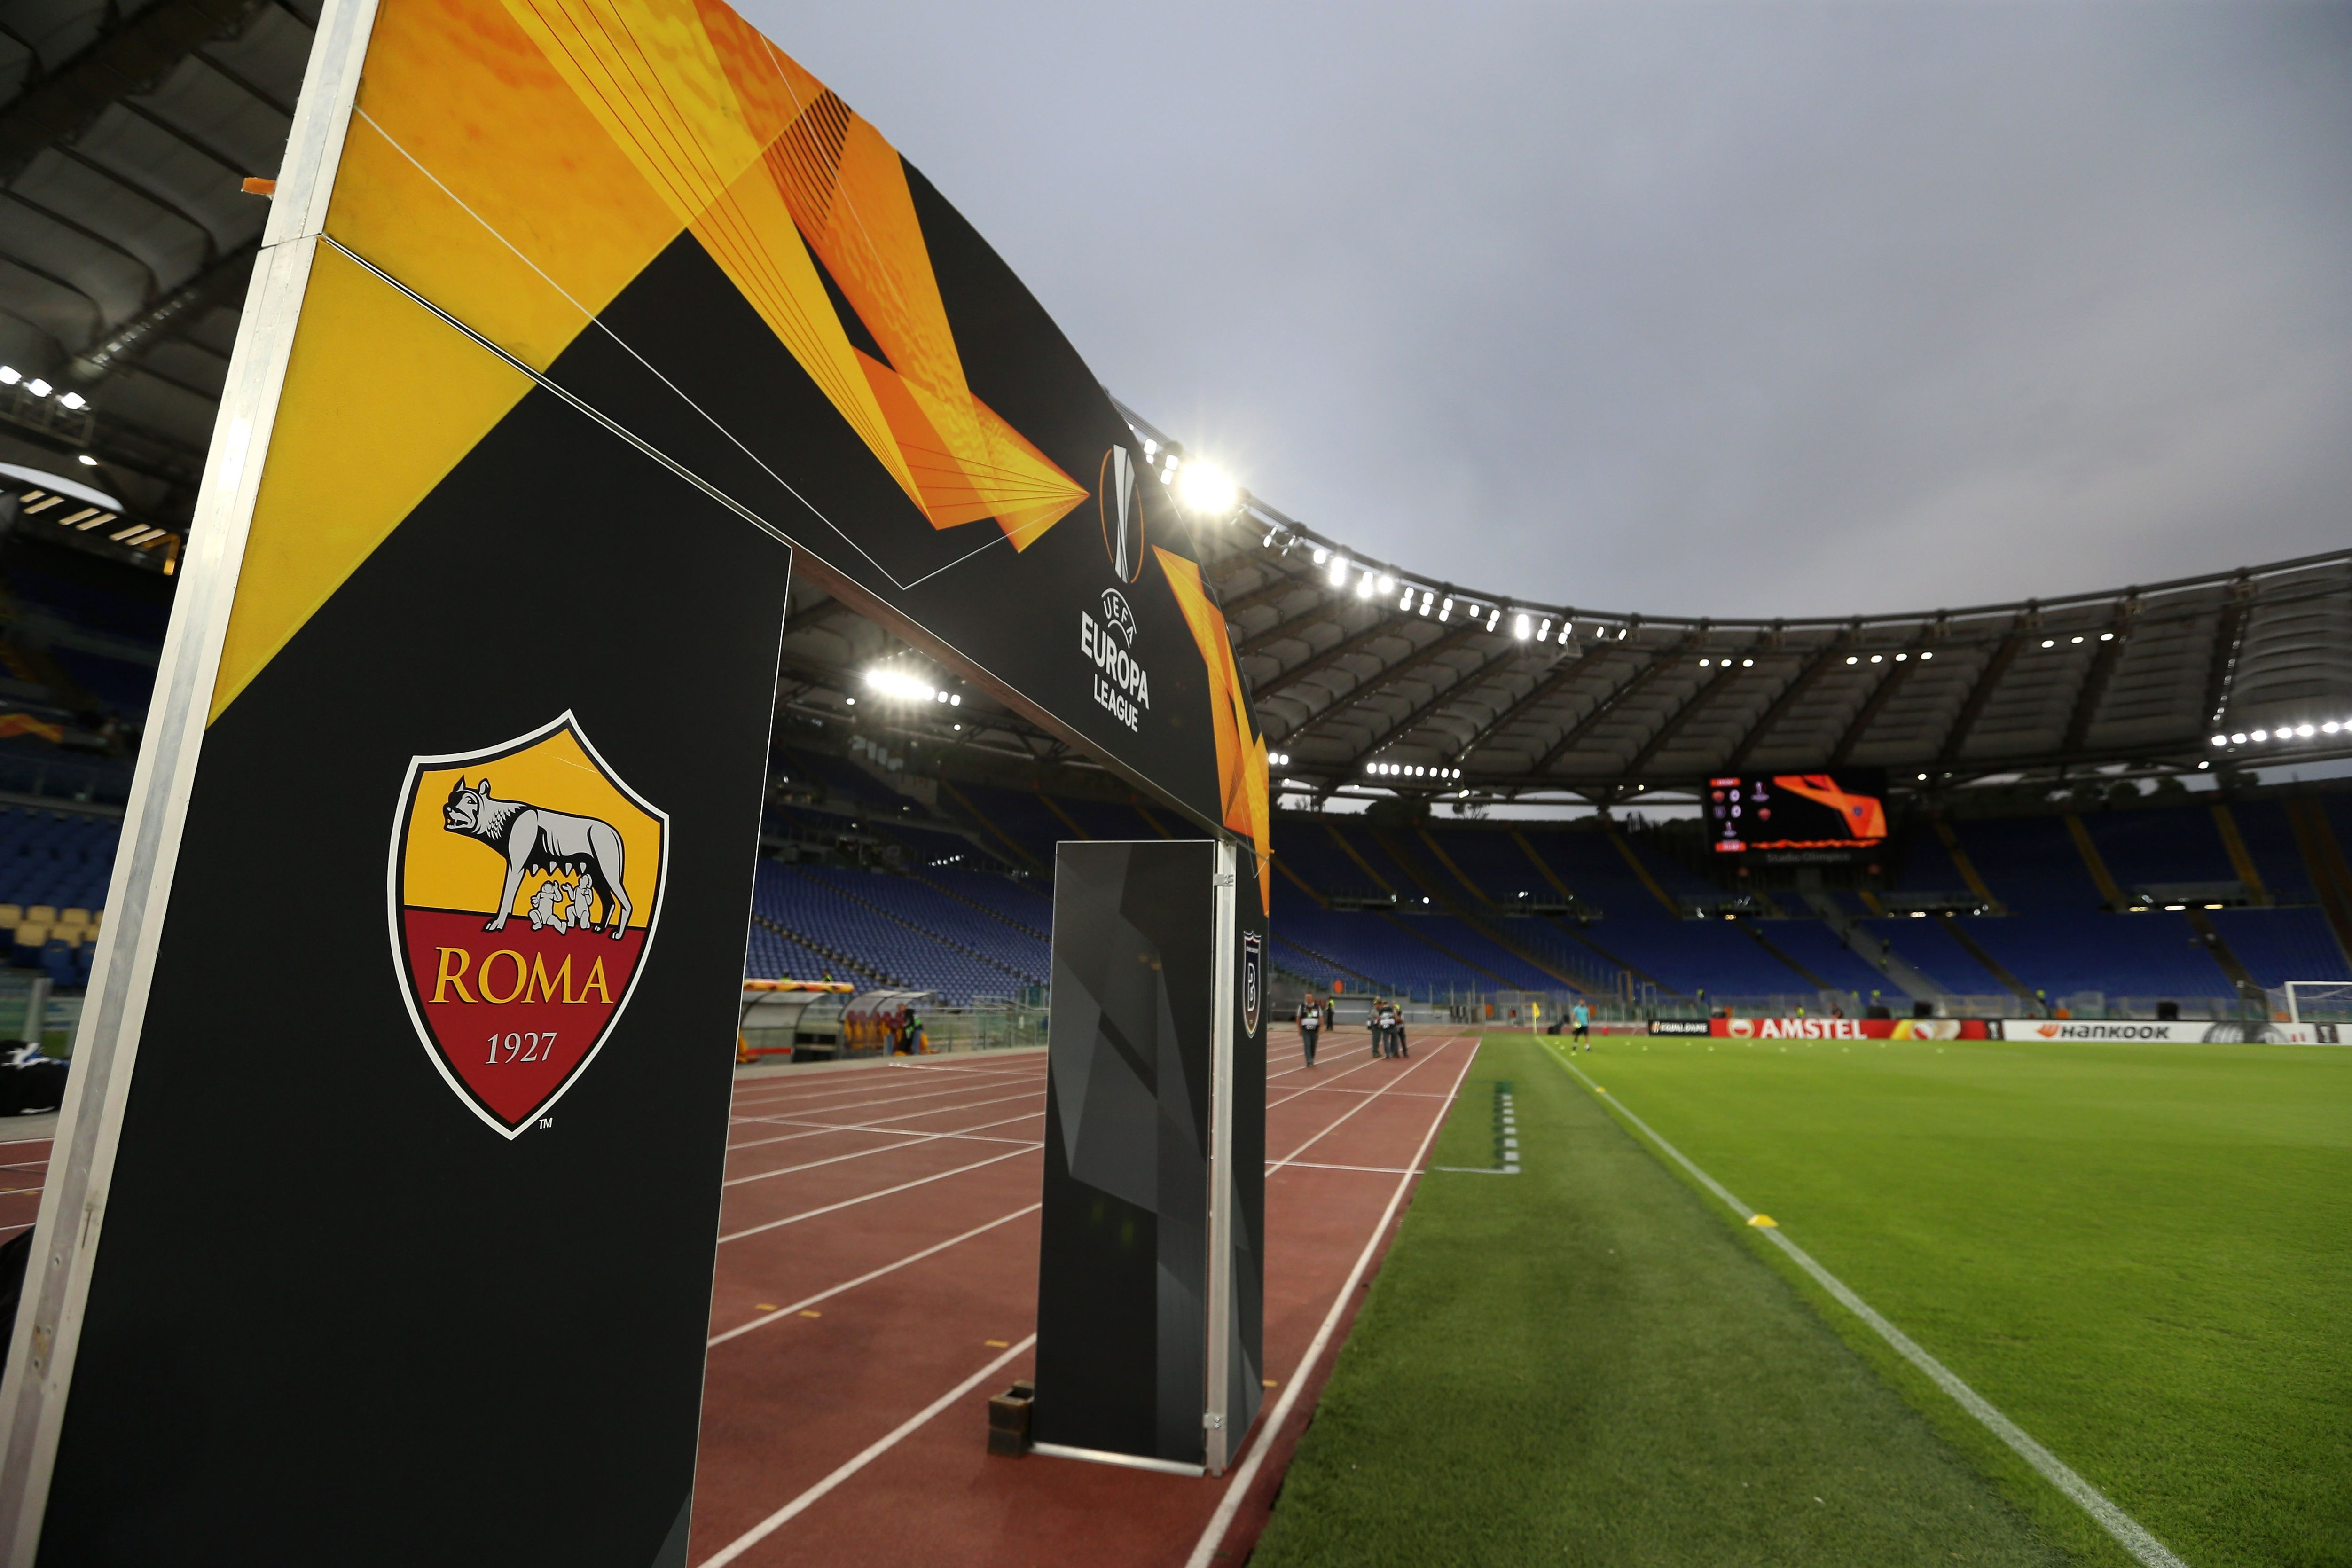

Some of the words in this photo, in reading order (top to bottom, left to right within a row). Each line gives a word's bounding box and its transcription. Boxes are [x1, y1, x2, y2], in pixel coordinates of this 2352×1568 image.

[1103, 595, 1134, 644] UEFA
[1081, 611, 1149, 709] EUROPA
[1094, 674, 1138, 732] LEAGUE
[428, 947, 614, 1004] ROMA
[485, 1032, 558, 1065] 1927
[1760, 1018, 1868, 1039] AMSTEL
[539, 1117, 553, 1129] TM
